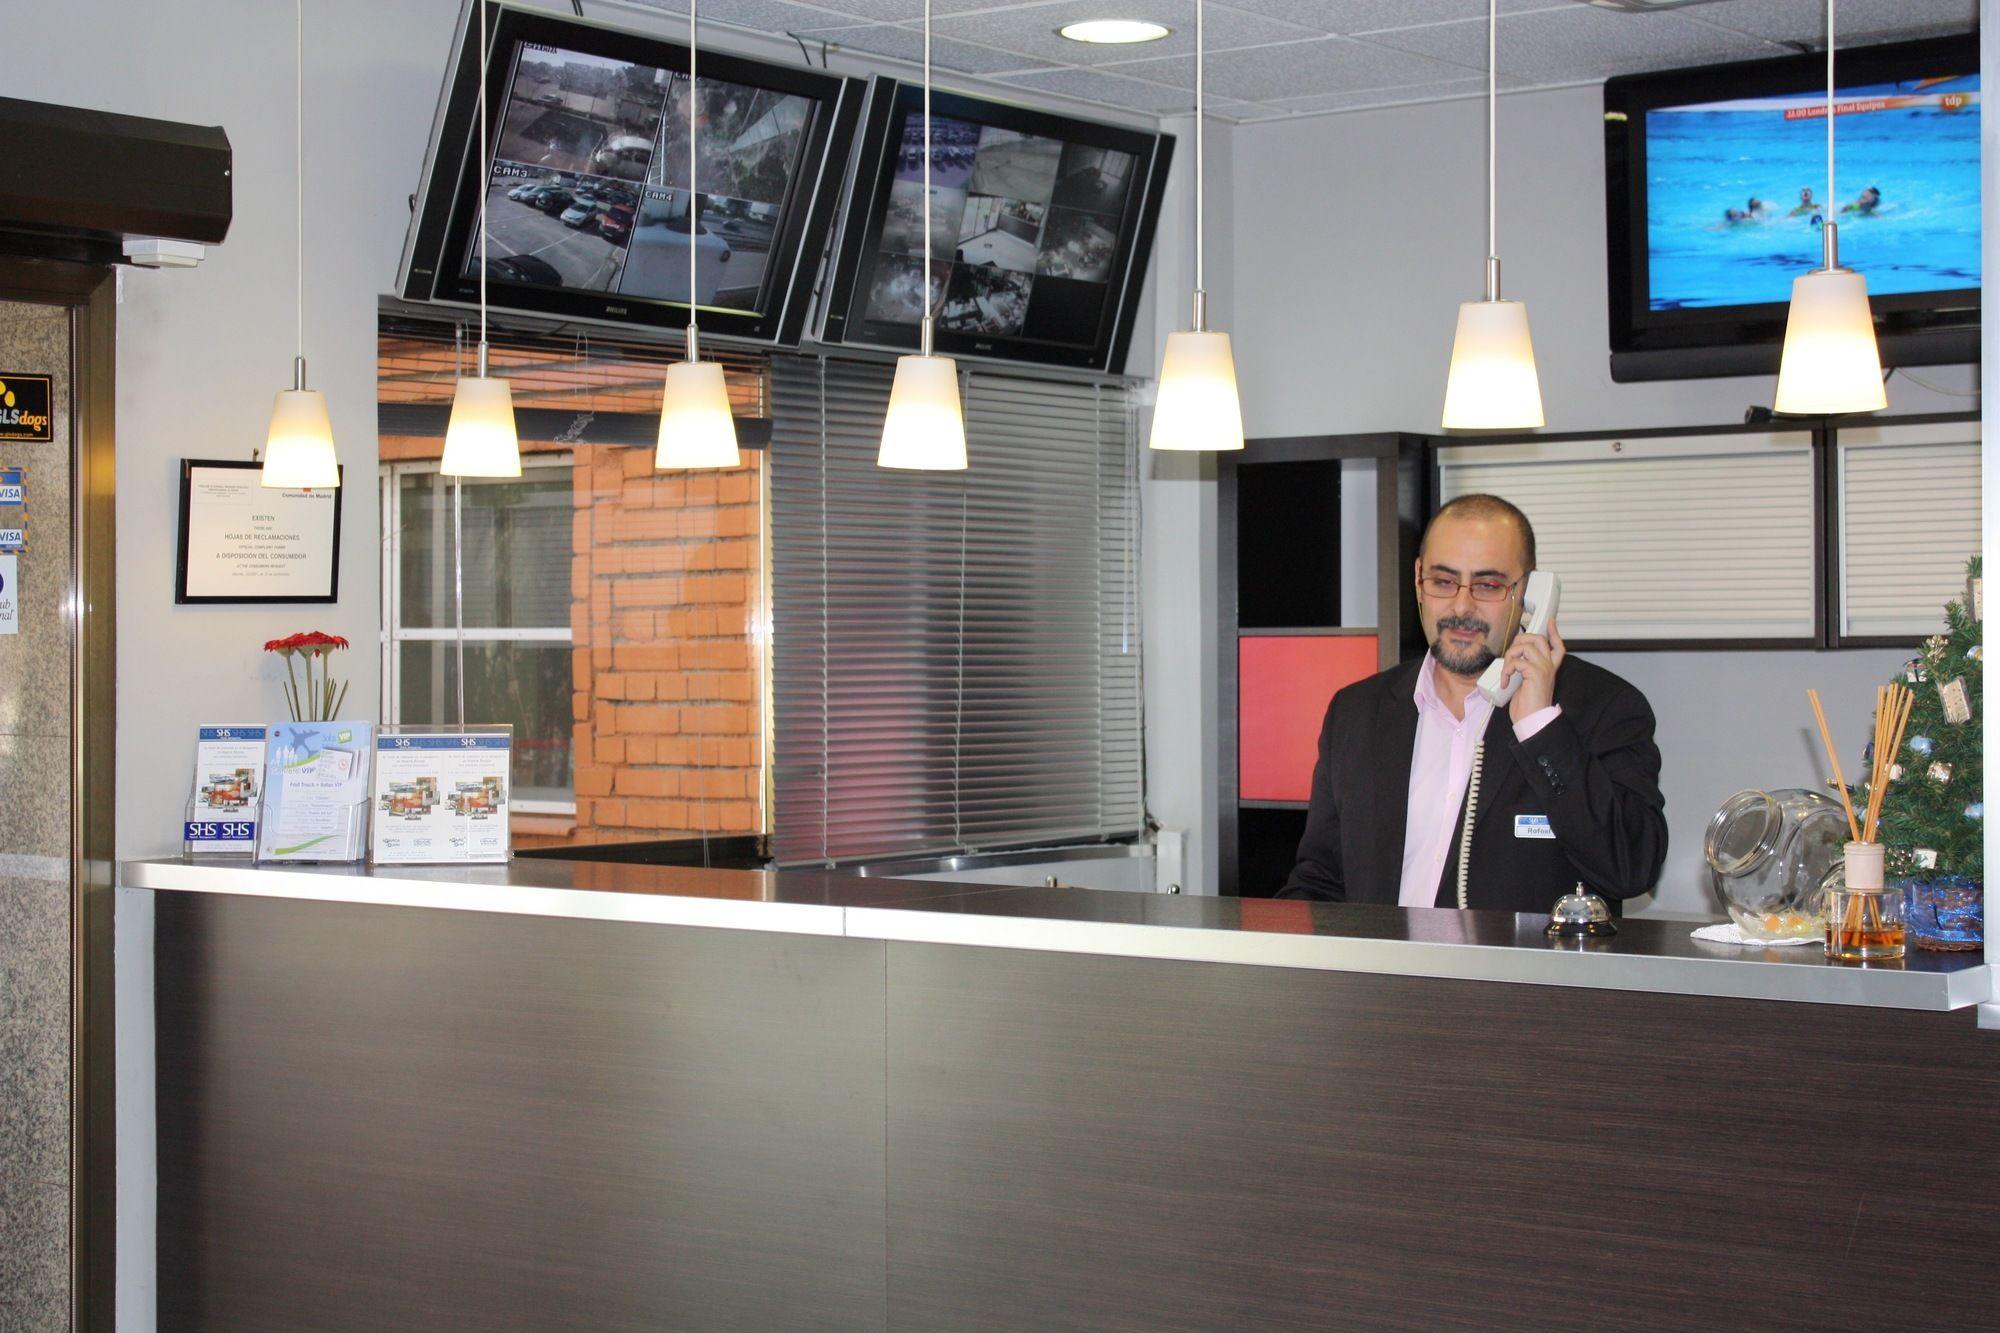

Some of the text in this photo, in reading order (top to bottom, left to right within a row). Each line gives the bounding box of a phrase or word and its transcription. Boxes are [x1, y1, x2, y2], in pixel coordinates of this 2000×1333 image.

[1945, 96, 1962, 107] tdp
[493, 165, 528, 178] CAM3
[645, 190, 672, 201] CAM4
[216, 728, 231, 737] SHS
[395, 738, 410, 747] SHS
[461, 738, 476, 746] SHS
[189, 823, 217, 836] SHS
[222, 823, 250, 836] SHS
